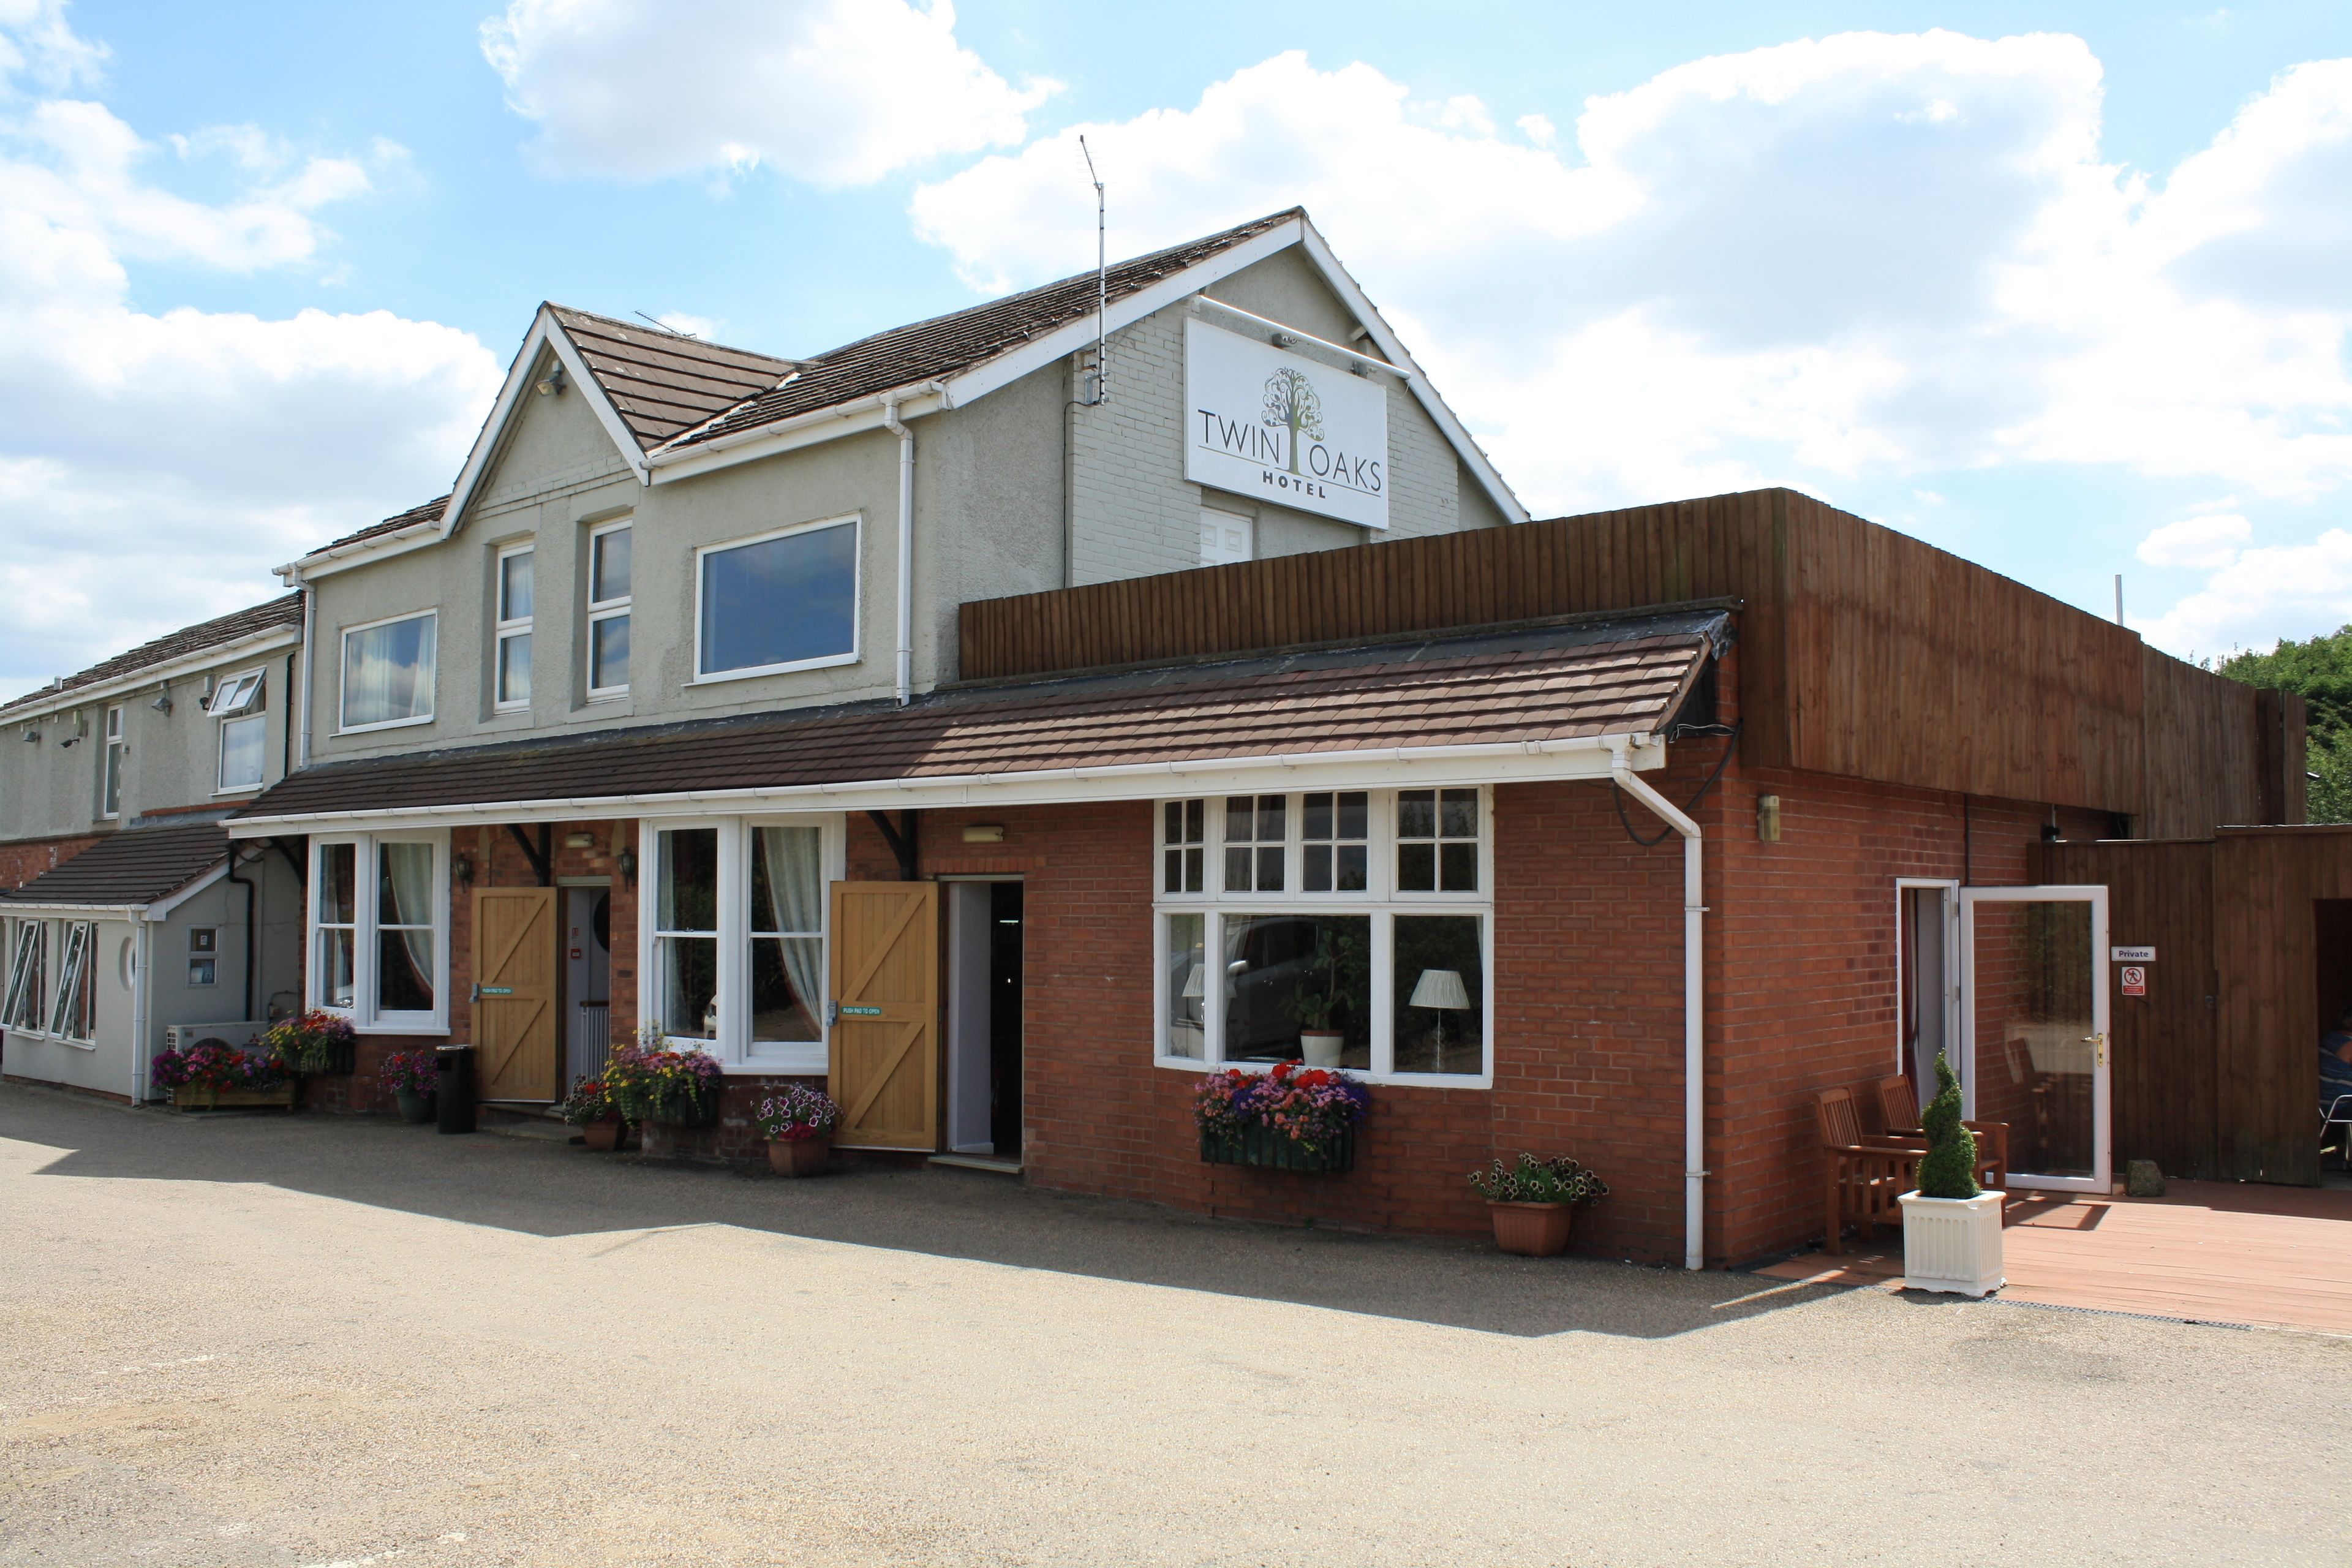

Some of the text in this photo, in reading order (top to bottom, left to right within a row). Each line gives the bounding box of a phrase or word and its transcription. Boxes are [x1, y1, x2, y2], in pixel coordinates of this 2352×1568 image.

[1198, 409, 1381, 492] TWIN OAKS
[1263, 471, 1325, 499] HOTEL
